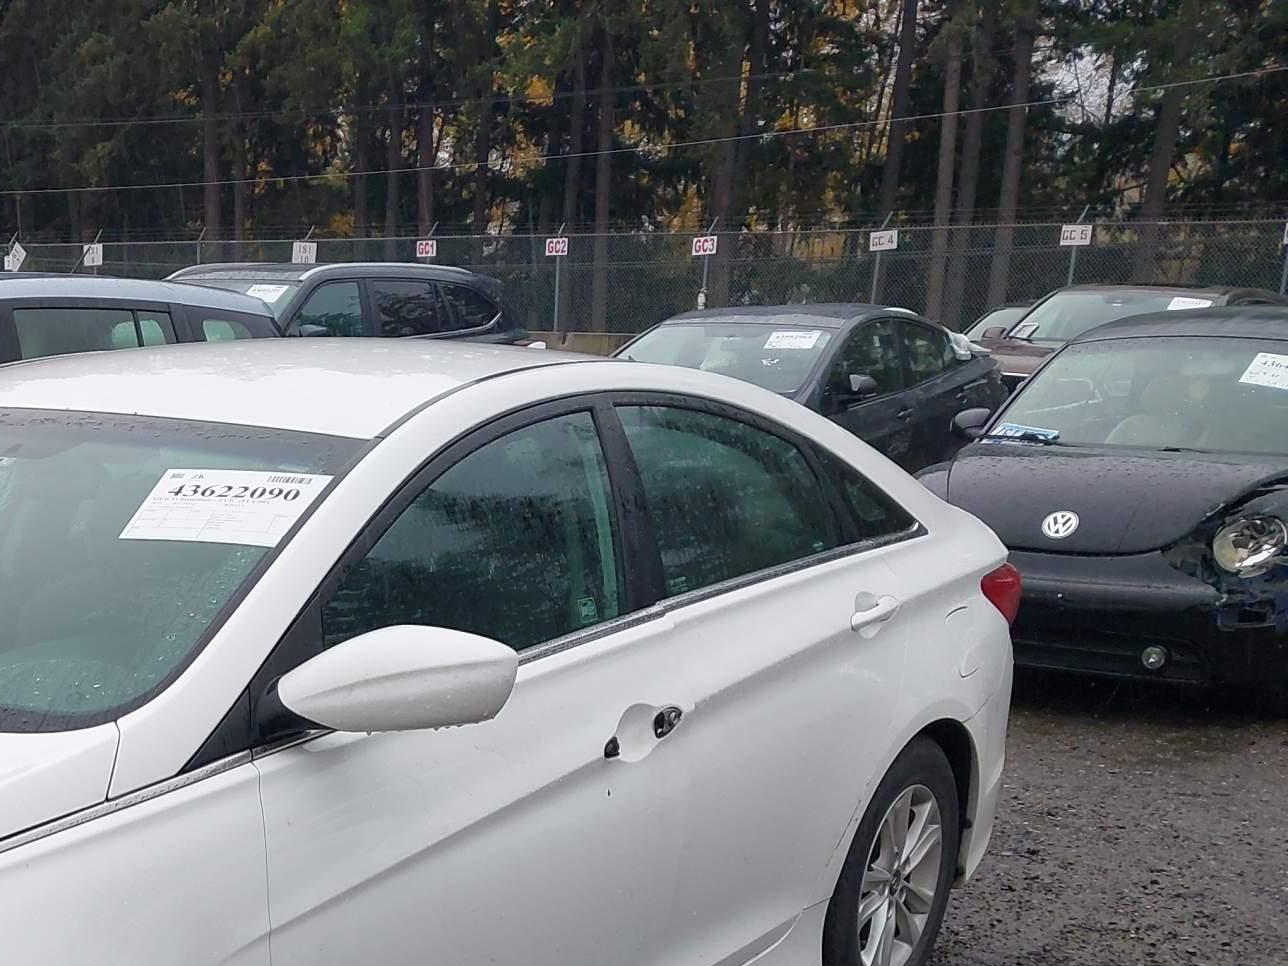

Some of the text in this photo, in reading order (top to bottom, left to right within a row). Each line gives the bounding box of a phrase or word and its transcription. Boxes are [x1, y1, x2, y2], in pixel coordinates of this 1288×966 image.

[418, 242, 433, 255] GC1
[548, 240, 566, 253] GC2
[695, 239, 714, 253] GC3
[168, 483, 300, 502] 43622090
